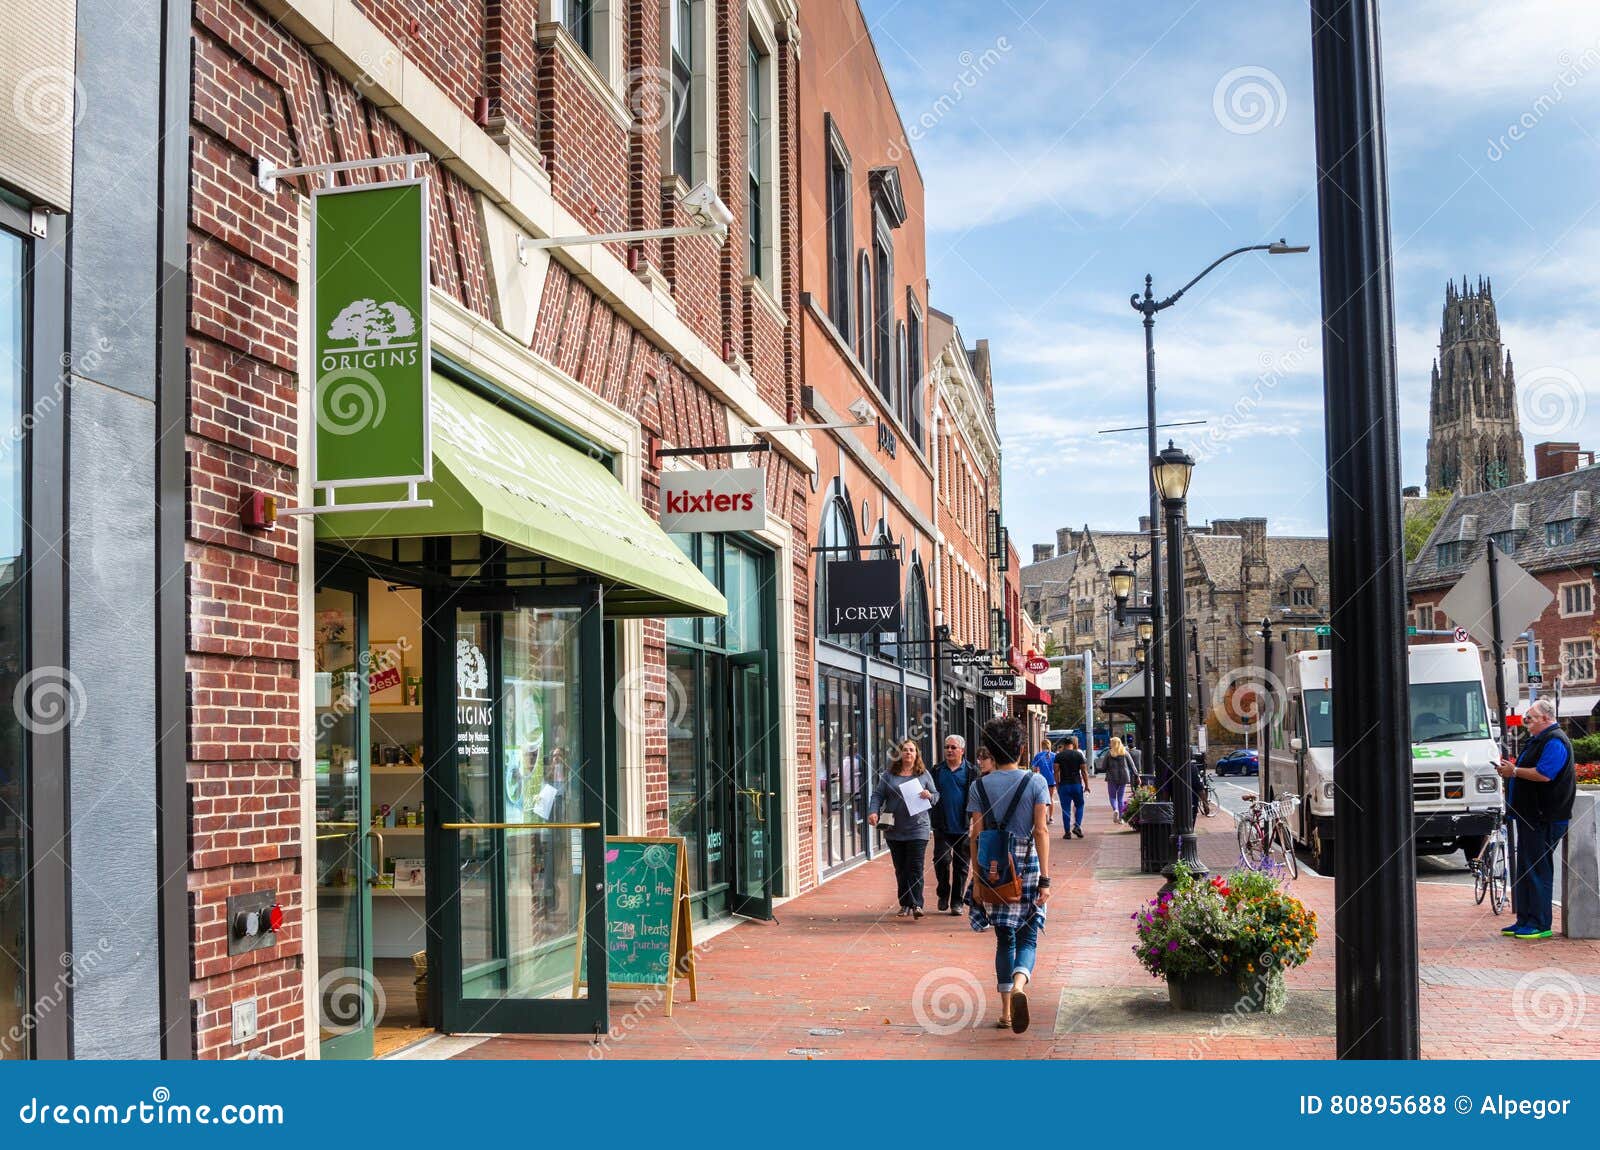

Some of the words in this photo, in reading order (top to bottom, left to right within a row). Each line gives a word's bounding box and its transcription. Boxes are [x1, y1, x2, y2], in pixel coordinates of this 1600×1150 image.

[322, 349, 417, 371] ORIGINS
[834, 606, 894, 626] J.CREW
[634, 884, 648, 893] on
[655, 881, 673, 896] the
[636, 913, 671, 937] Treats
